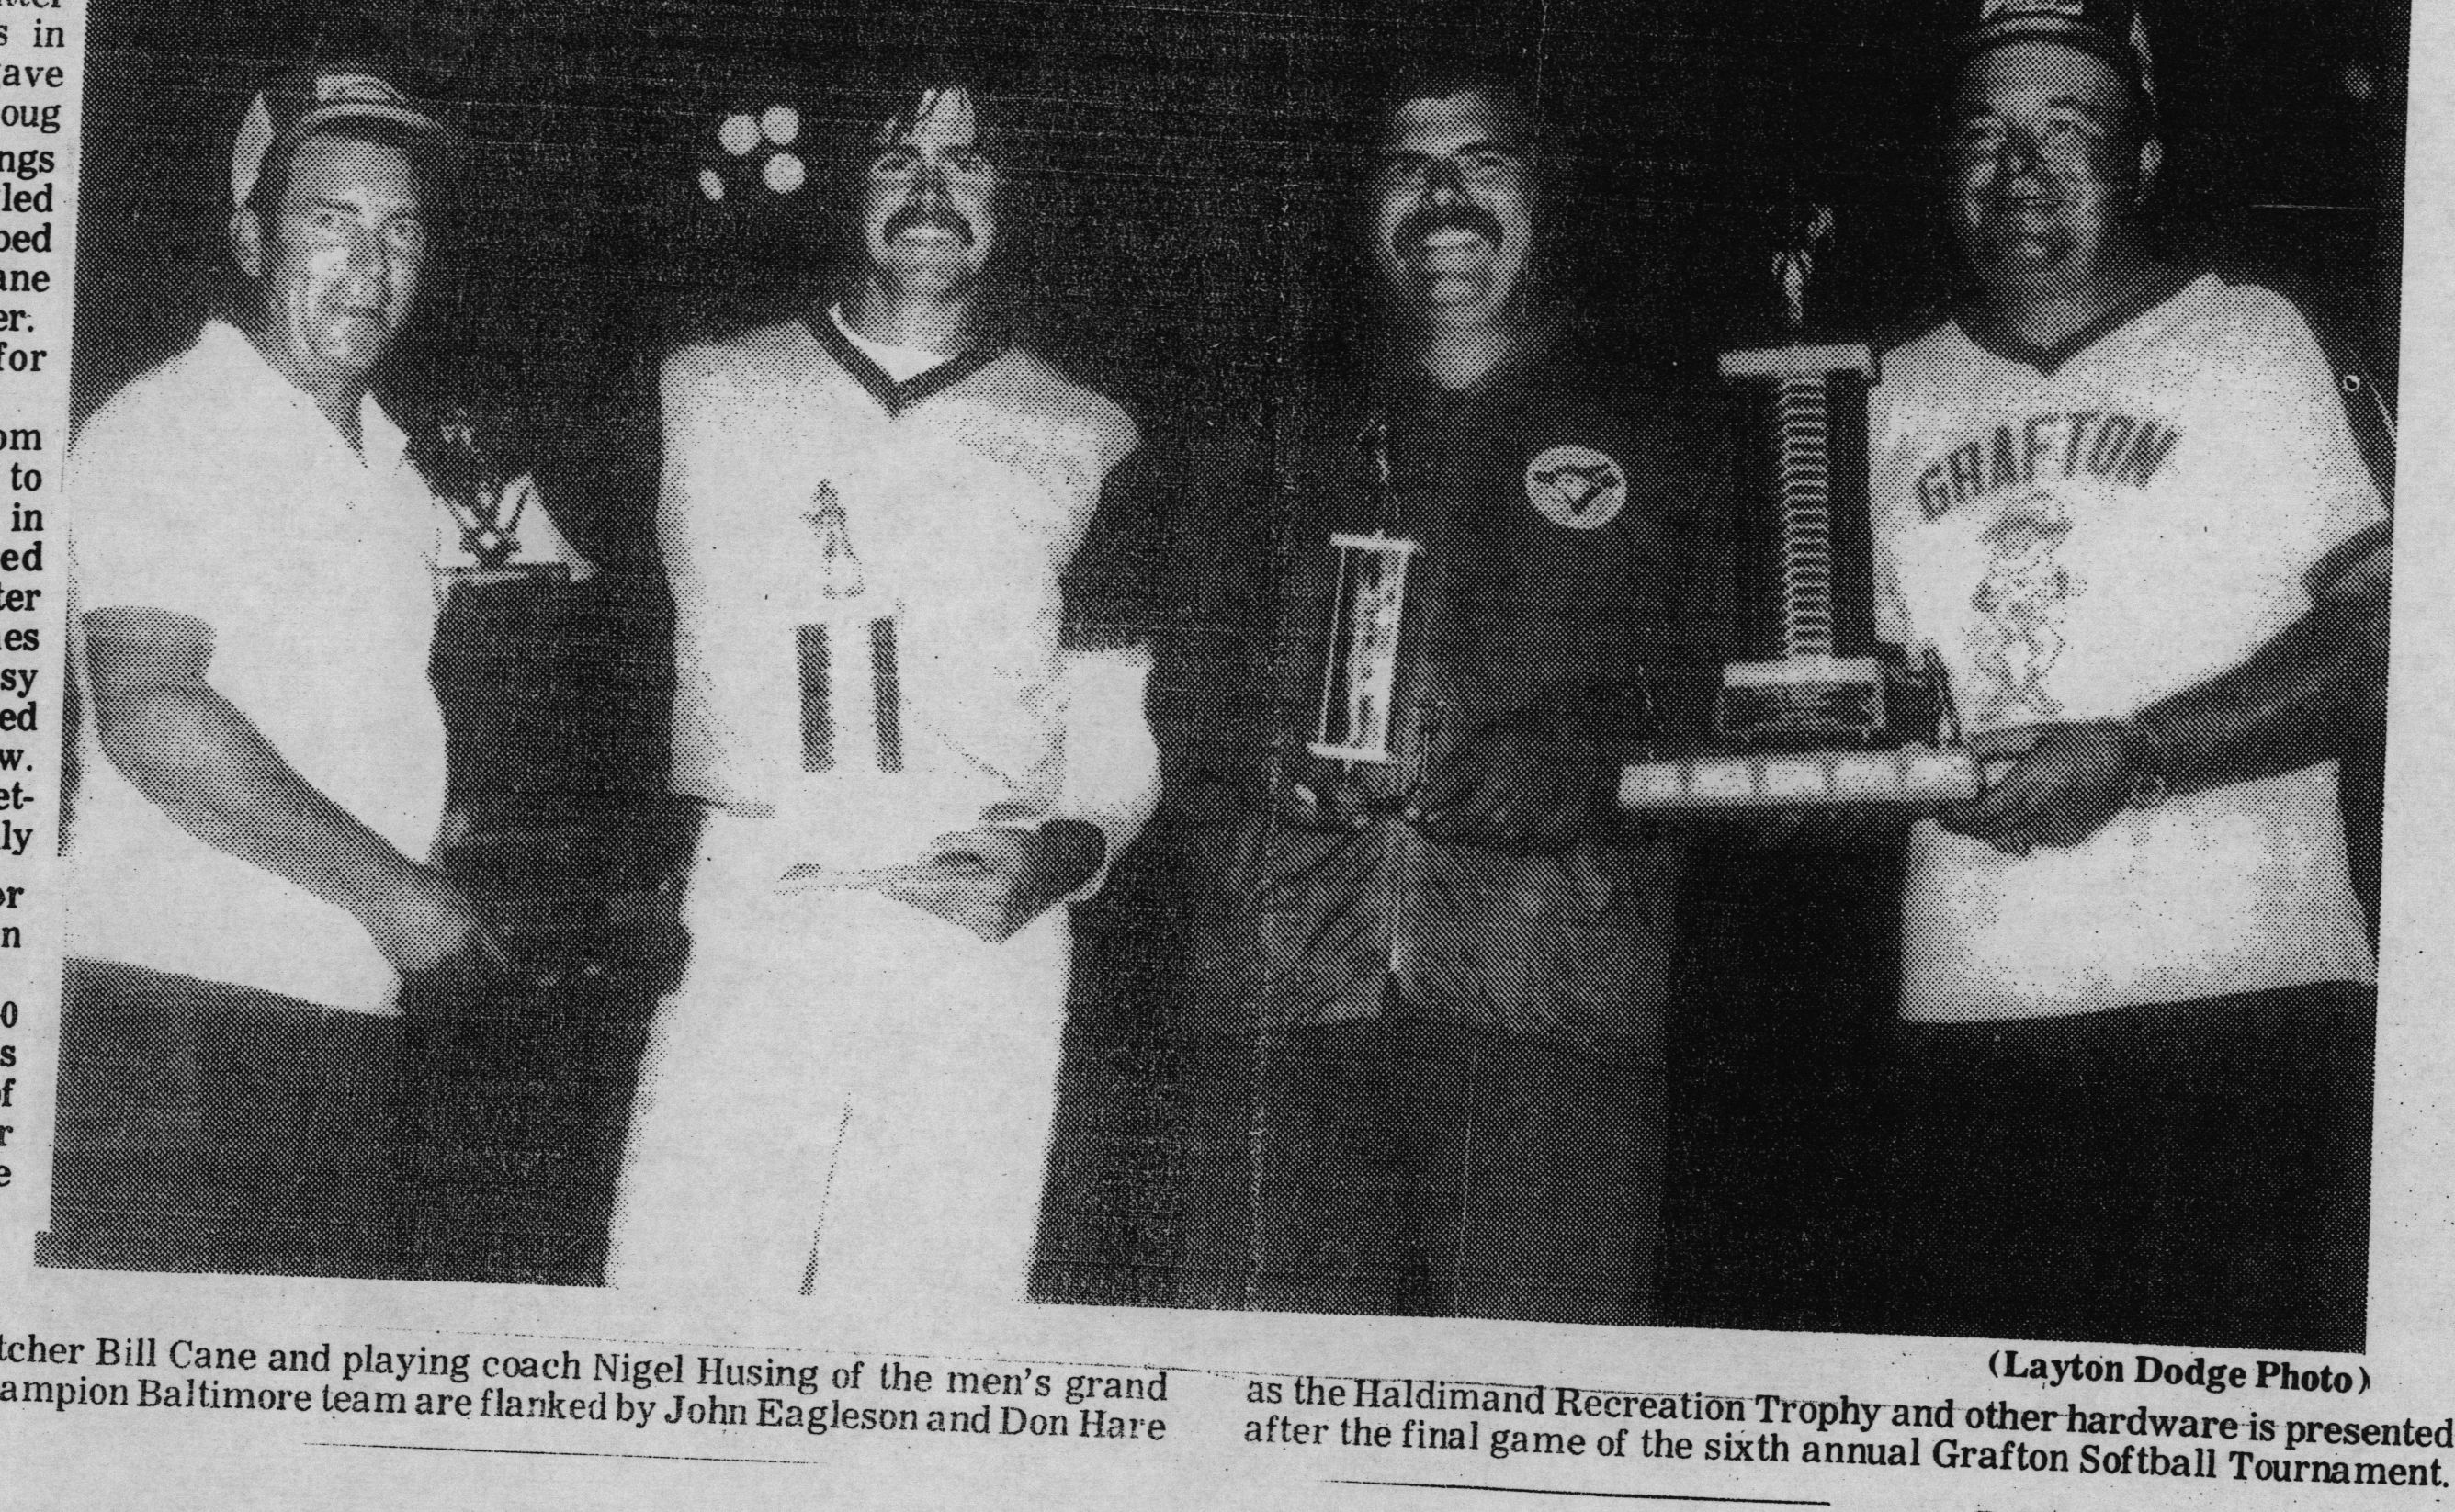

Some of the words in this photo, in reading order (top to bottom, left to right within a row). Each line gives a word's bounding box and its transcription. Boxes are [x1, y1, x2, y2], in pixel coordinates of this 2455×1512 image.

[33, 18, 64, 47] in
[0, 63, 63, 87] ave
[11, 462, 42, 491] to
[1917, 411, 2181, 522] GRAFTON
[11, 502, 43, 532] in
[0, 629, 40, 651] es
[96, 1338, 156, 1367] Bill
[169, 1340, 256, 1370] Cane
[268, 1343, 329, 1371] and
[343, 1344, 470, 1382] playing
[483, 1350, 581, 1380] coach
[594, 1353, 684, 1389] Nigel
[697, 1358, 818, 1394] Husing
[832, 1361, 865, 1389] of
[880, 1362, 932, 1392] the
[947, 1368, 1050, 1396] men's
[1066, 1371, 1167, 1405] grand
[1989, 1350, 2124, 1385] (Layton
[2134, 1356, 2246, 1394] Dodge
[2256, 1360, 2370, 1394] Photo)
[137, 1379, 311, 1411] Baltimore
[322, 1384, 406, 1413] team
[415, 1394, 471, 1416] are
[481, 1388, 607, 1420] flanked
[616, 1393, 656, 1428] by
[664, 1395, 747, 1425] John
[756, 1398, 917, 1435] Eagleson
[927, 1405, 990, 1433] and
[1000, 1406, 1068, 1435] Don
[1080, 1409, 1166, 1440] Hare
[1247, 1381, 1282, 1404] as
[1295, 1375, 1345, 1406] the
[1353, 1378, 1544, 1414] Haldimand
[1555, 1387, 1745, 1421] Recreation
[1755, 1394, 1882, 1432] Trophy
[1892, 1399, 1954, 1428] and
[1965, 1401, 2058, 1431] other
[2067, 1404, 2238, 1439] hardware
[2249, 1412, 2276, 1441] is
[2285, 1418, 2454, 1450] presented
[1245, 1415, 1329, 1444] after
[1341, 1417, 1391, 1447] the
[1402, 1419, 1478, 1450] final
[1490, 1429, 1586, 1459] game
[1597, 1428, 1628, 1457] of
[1642, 1429, 1692, 1459] the
[1705, 1432, 1789, 1462] sixth
[1802, 1438, 1920, 1466] annual
[1933, 1439, 2068, 1472] Grafton
[2080, 1445, 2216, 1478] Softball
[2229, 1451, 2449, 1488] Tournament.
